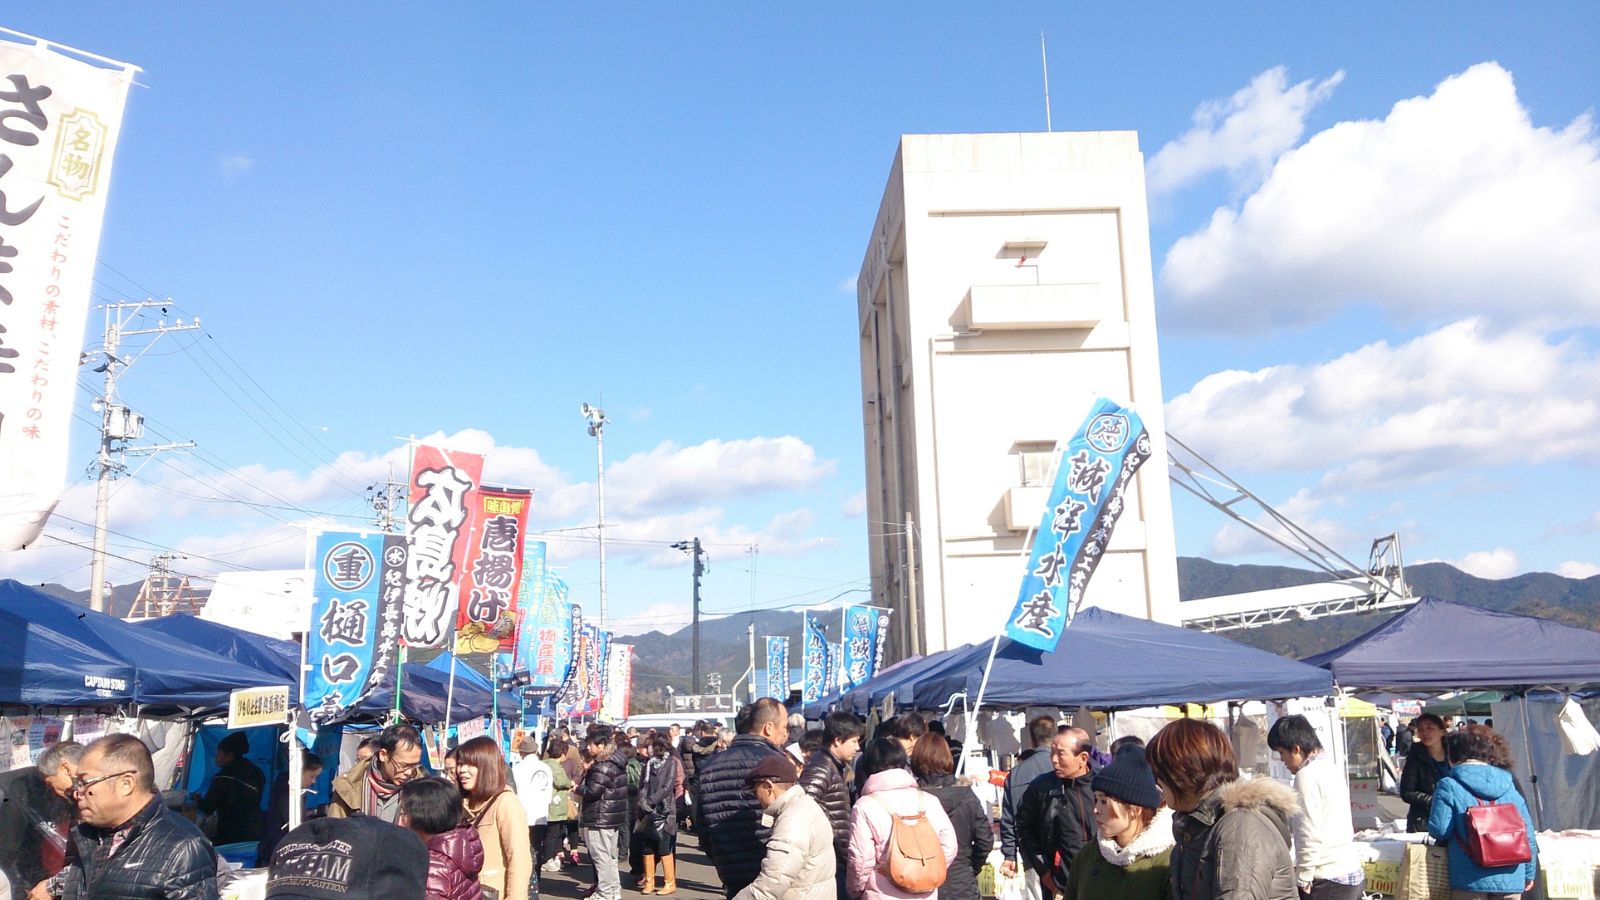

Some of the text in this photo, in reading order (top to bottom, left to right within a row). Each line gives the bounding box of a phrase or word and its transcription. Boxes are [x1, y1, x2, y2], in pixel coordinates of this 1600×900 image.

[61, 126, 92, 182] 名物
[21, 213, 71, 440] こだわりの素材、こだわりの味
[385, 546, 405, 566] 水
[467, 515, 518, 624] 唐揚げ
[84, 675, 126, 691] CAPTAIN STAG
